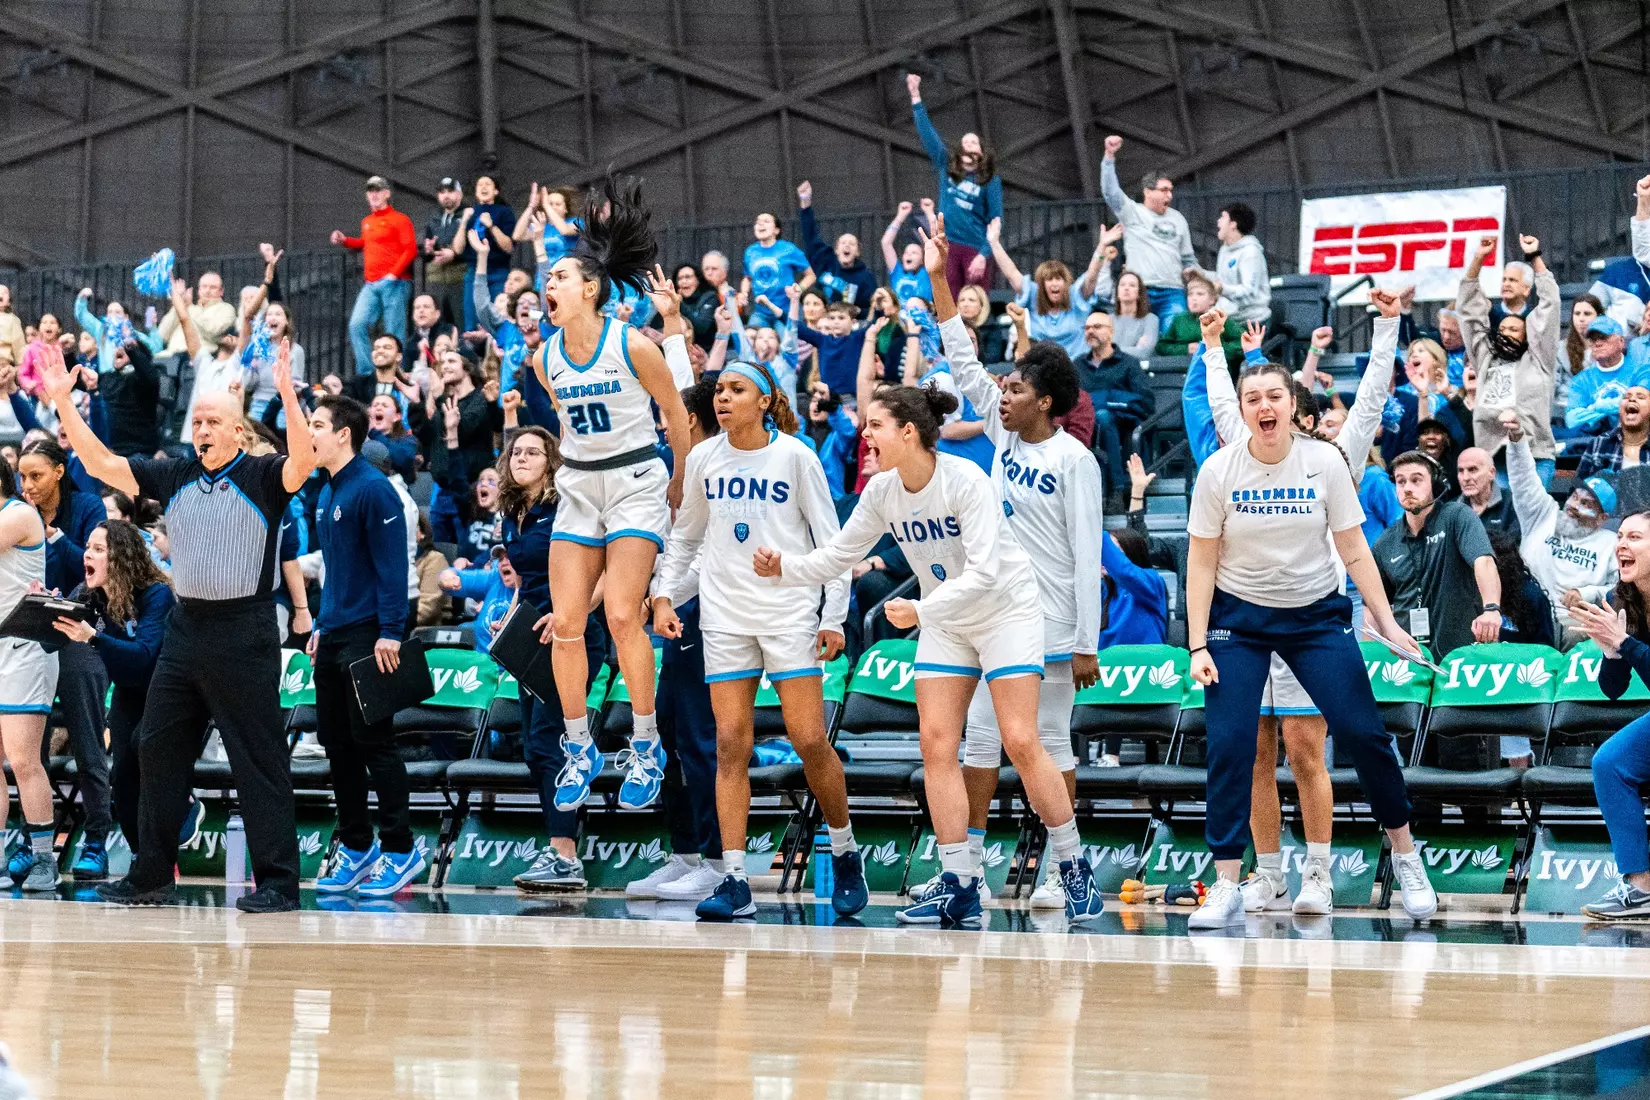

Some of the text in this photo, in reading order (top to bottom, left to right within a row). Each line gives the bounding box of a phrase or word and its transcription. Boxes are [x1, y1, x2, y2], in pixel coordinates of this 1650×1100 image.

[1309, 217, 1499, 276] ESPN
[554, 380, 622, 400] OLUMBIA
[567, 402, 611, 435] 20
[704, 477, 790, 503] LIONS
[1232, 488, 1316, 502] COLUMBIA
[1236, 504, 1312, 515] BASKETBALL
[890, 516, 961, 543] LIONS
[1552, 546, 1597, 571] VERSITY
[857, 650, 915, 691] Ivy
[1445, 657, 1515, 696] Ivy
[1563, 651, 1602, 683] Iv
[192, 831, 219, 858] vy
[460, 832, 514, 867] Ivy
[582, 835, 638, 868] Ivy
[1281, 846, 1337, 873] Iv
[1153, 843, 1214, 880] Ivy
[1536, 850, 1602, 889] Ivy
